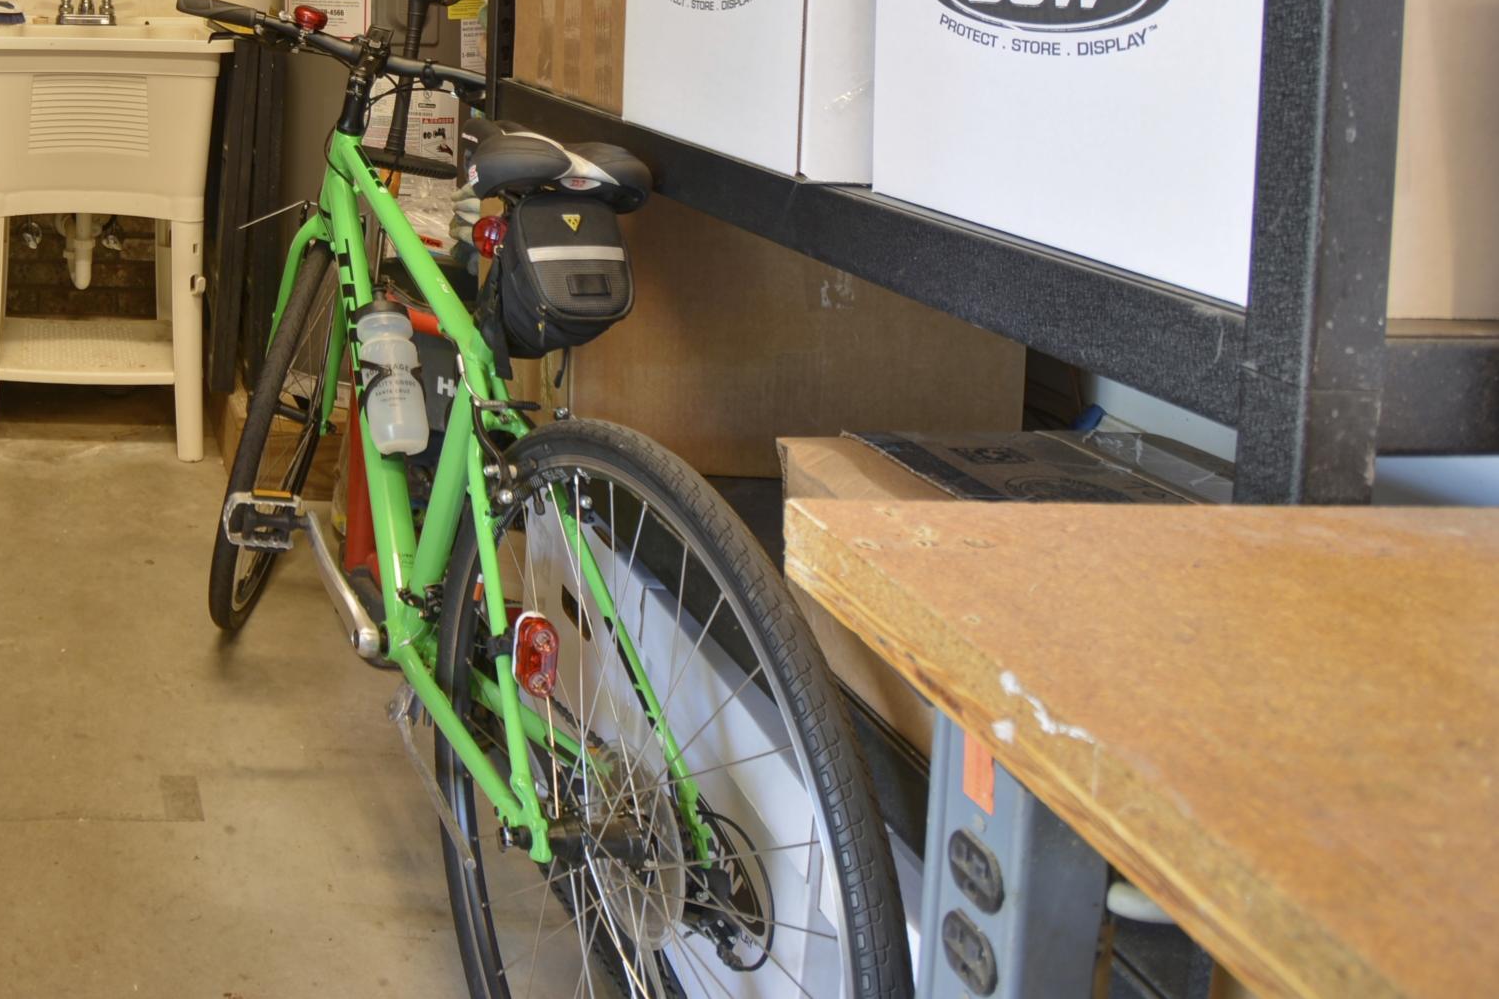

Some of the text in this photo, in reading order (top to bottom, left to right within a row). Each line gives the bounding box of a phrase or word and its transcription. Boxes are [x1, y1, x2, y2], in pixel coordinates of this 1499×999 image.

[692, 0, 714, 10] STORE
[939, 14, 1147, 56] PROTECT STORE DISPLAY
